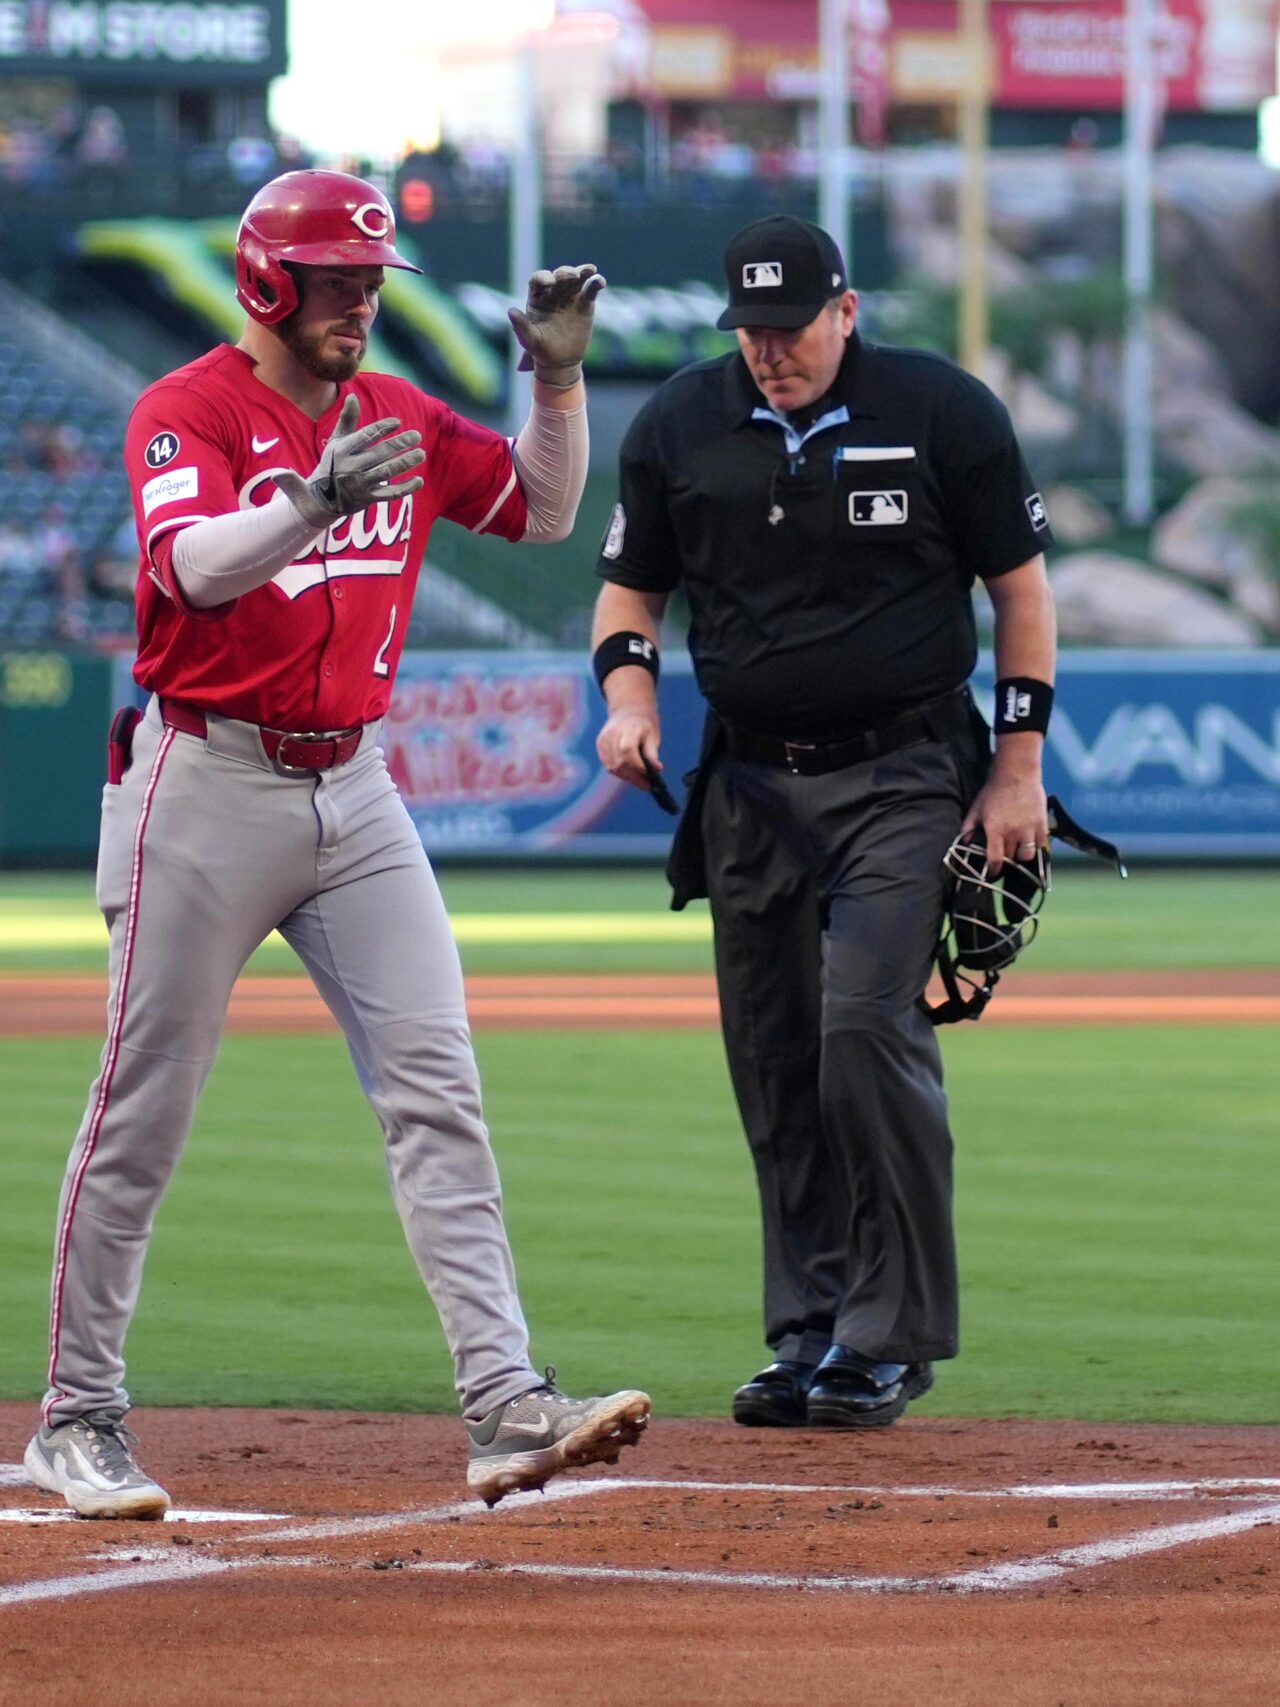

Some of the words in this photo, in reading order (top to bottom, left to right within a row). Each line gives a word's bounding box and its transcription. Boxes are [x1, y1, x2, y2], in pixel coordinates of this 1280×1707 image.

[103, 3, 269, 62] STORE
[350, 202, 389, 239] C
[150, 436, 173, 463] 14
[154, 479, 191, 496] Kroger
[238, 467, 413, 575] eds
[373, 603, 396, 678] 2
[386, 668, 572, 734] ersey
